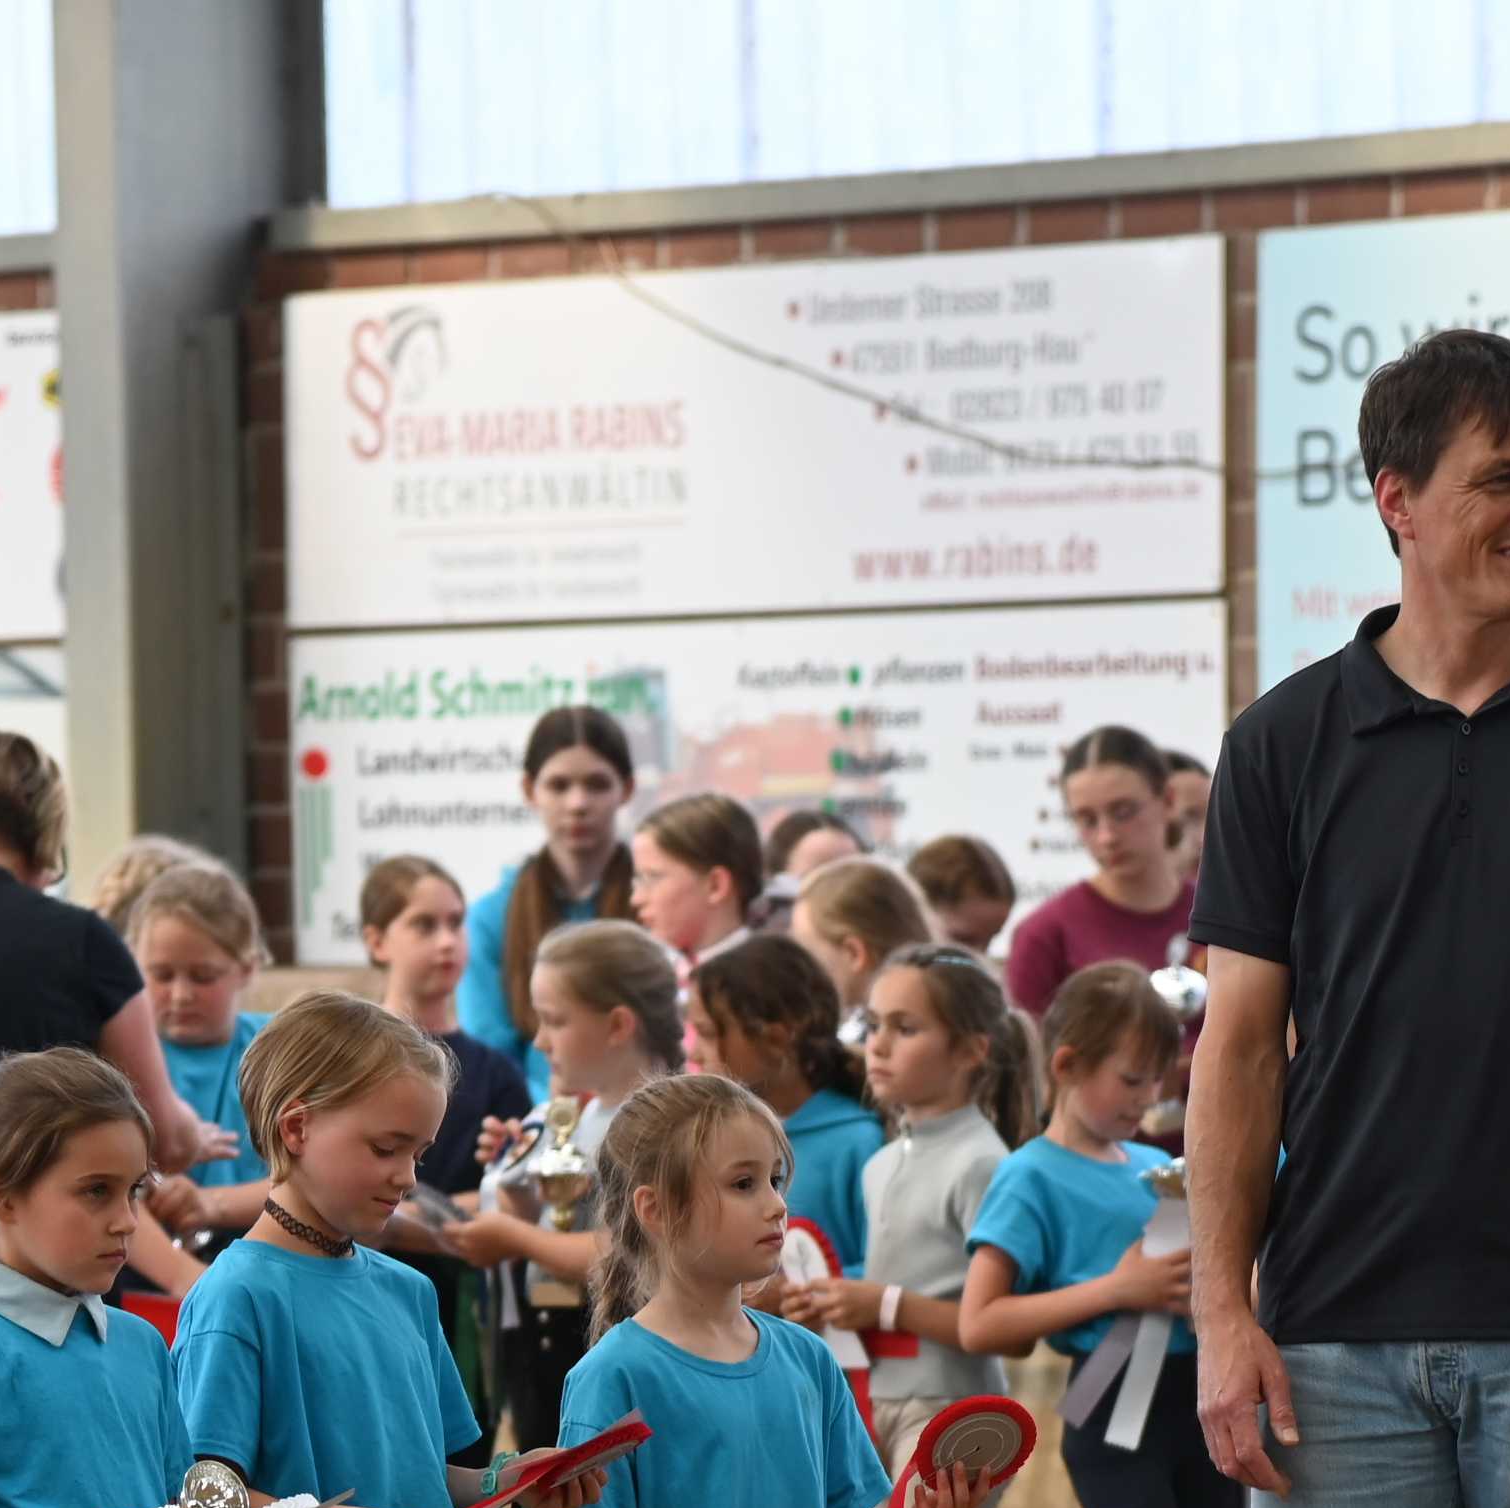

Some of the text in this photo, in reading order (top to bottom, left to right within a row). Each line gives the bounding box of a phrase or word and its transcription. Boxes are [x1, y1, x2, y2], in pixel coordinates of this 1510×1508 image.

[1295, 304, 1378, 385] So
[396, 400, 685, 460] EVA-MARIA RABINS
[396, 466, 687, 518] RECHTSANWÄLTIN
[853, 533, 1098, 581] www.rabins.de
[977, 651, 1188, 680] Bodenbearbeitung
[300, 670, 417, 722] Arnold
[430, 666, 574, 718] Schmitz
